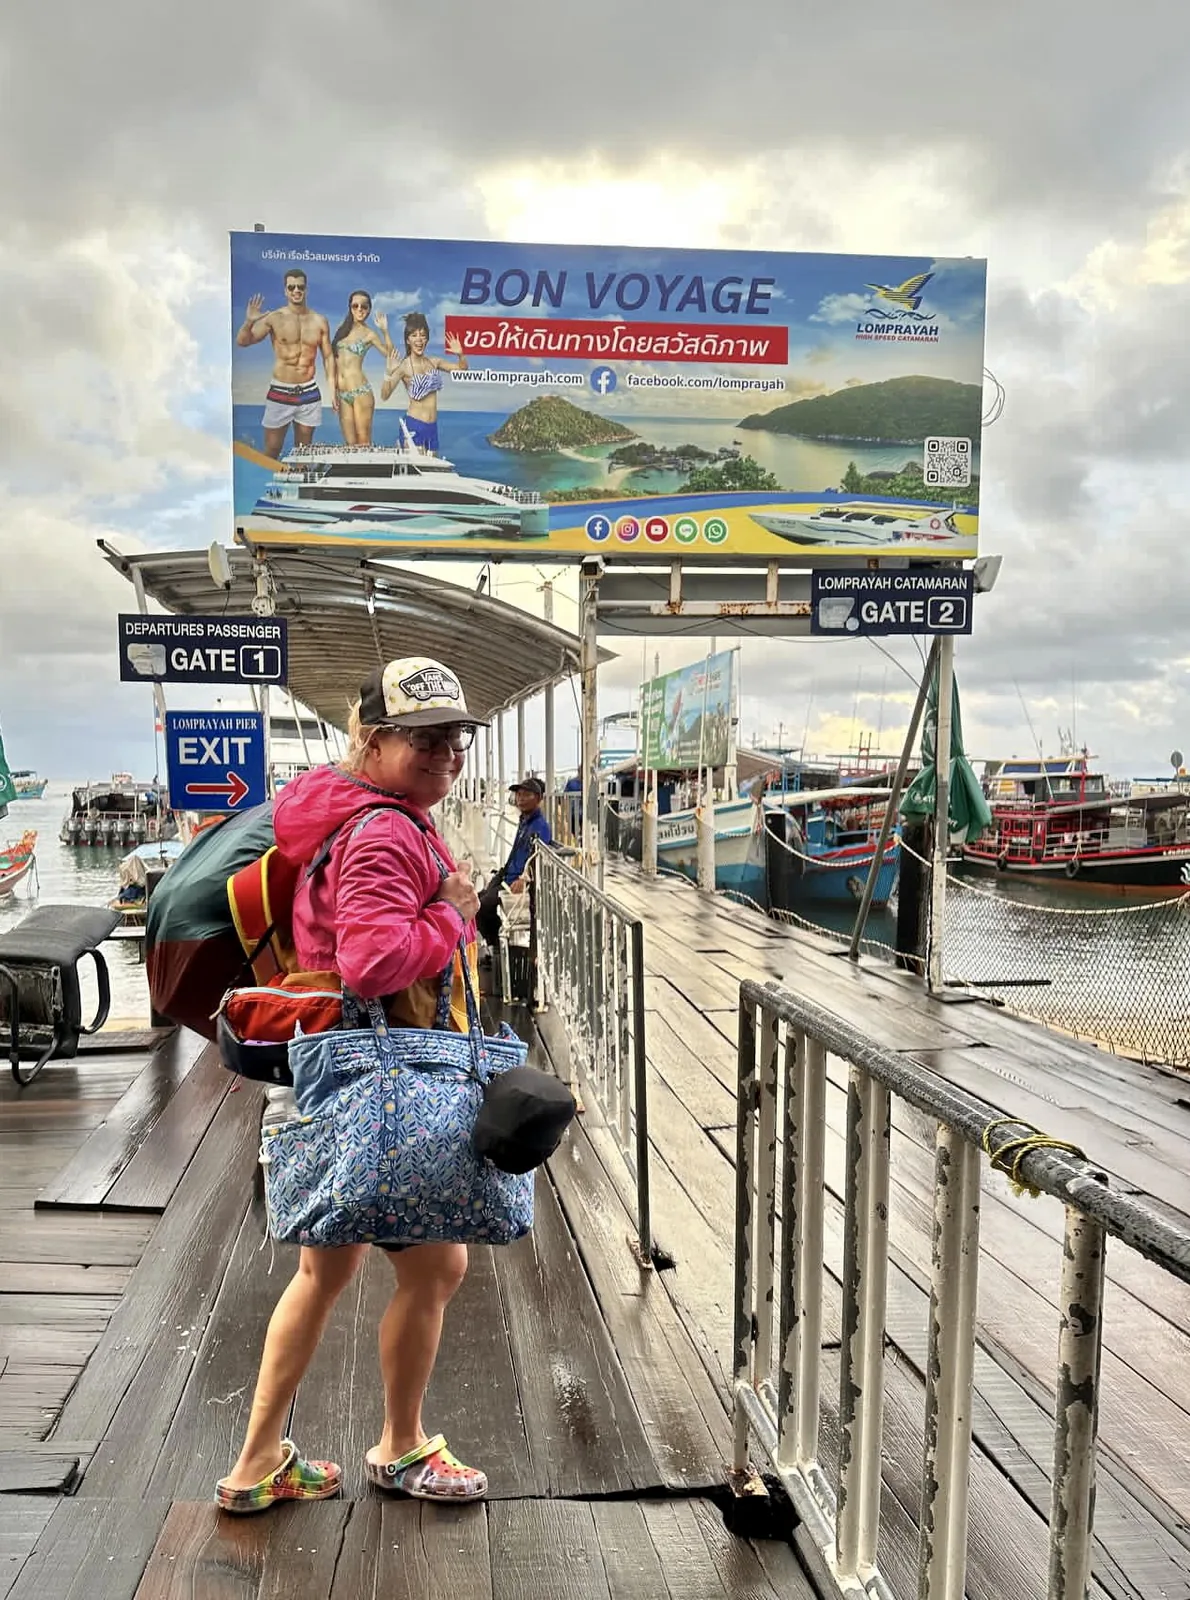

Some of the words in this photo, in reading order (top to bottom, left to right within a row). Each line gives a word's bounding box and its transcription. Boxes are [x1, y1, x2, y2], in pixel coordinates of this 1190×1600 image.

[460, 267, 567, 307] BON
[585, 271, 776, 315] VOYAGE
[857, 323, 939, 336] LOMPRAYAH
[463, 322, 770, 357] ขอให้เดินทางโดยสวัสดิภาพ
[897, 335, 939, 343] CATAMARAN
[452, 369, 583, 386] www.lomprayah.com
[628, 374, 784, 391] facebook.com/lomprayah
[818, 576, 891, 590] LOMPRAYAH
[894, 576, 967, 590] CATAMARAN
[861, 601, 925, 623] GATE
[938, 601, 954, 623] 2
[125, 622, 204, 637] DEPARTURES
[207, 625, 281, 639] PASSENGER
[171, 648, 237, 672] GATE
[253, 651, 265, 673] 1
[173, 717, 233, 730] LOMPRAYAH
[235, 718, 257, 730] PIER
[178, 737, 252, 765] EXIT
